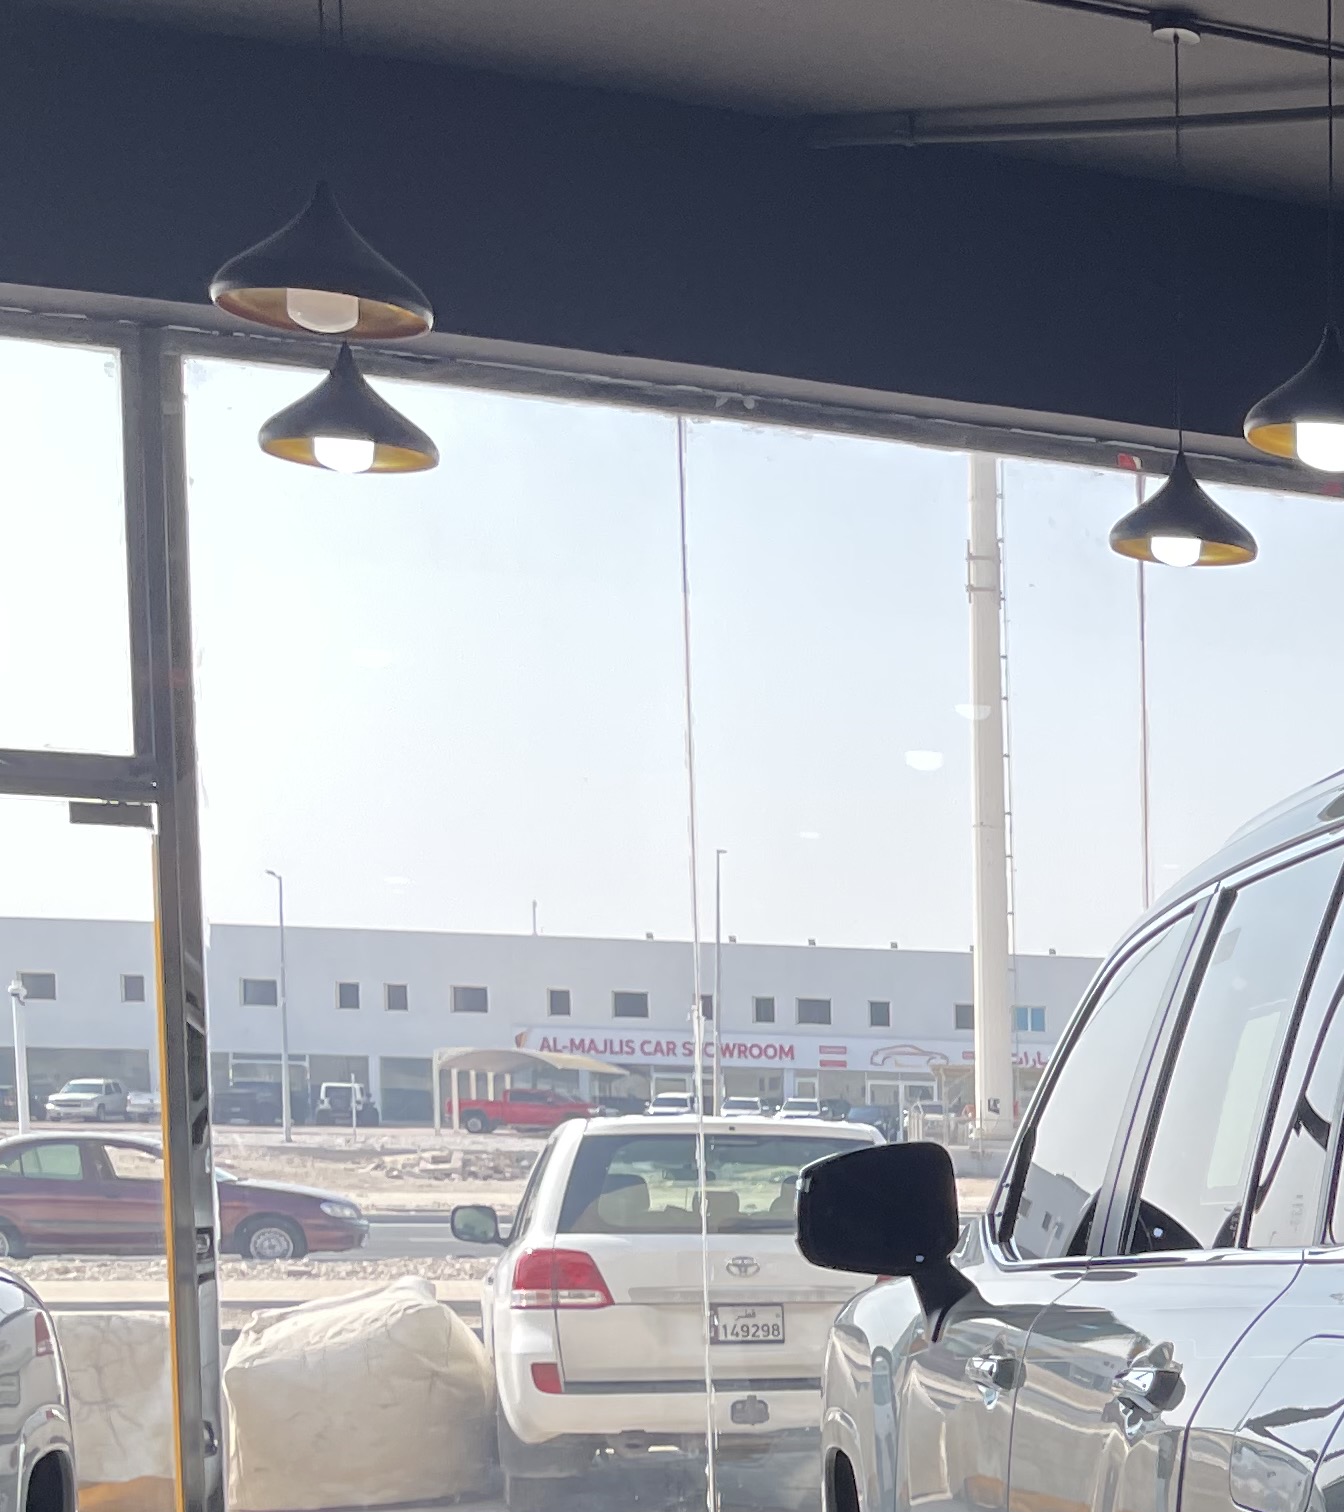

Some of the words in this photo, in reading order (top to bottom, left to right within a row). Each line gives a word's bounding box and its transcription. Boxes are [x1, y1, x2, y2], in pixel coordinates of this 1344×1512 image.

[539, 1036, 635, 1057] AL-MAJLIS
[640, 1039, 677, 1058] CAR
[682, 1041, 796, 1061] SOWROOM
[722, 1323, 781, 1339] 149298
